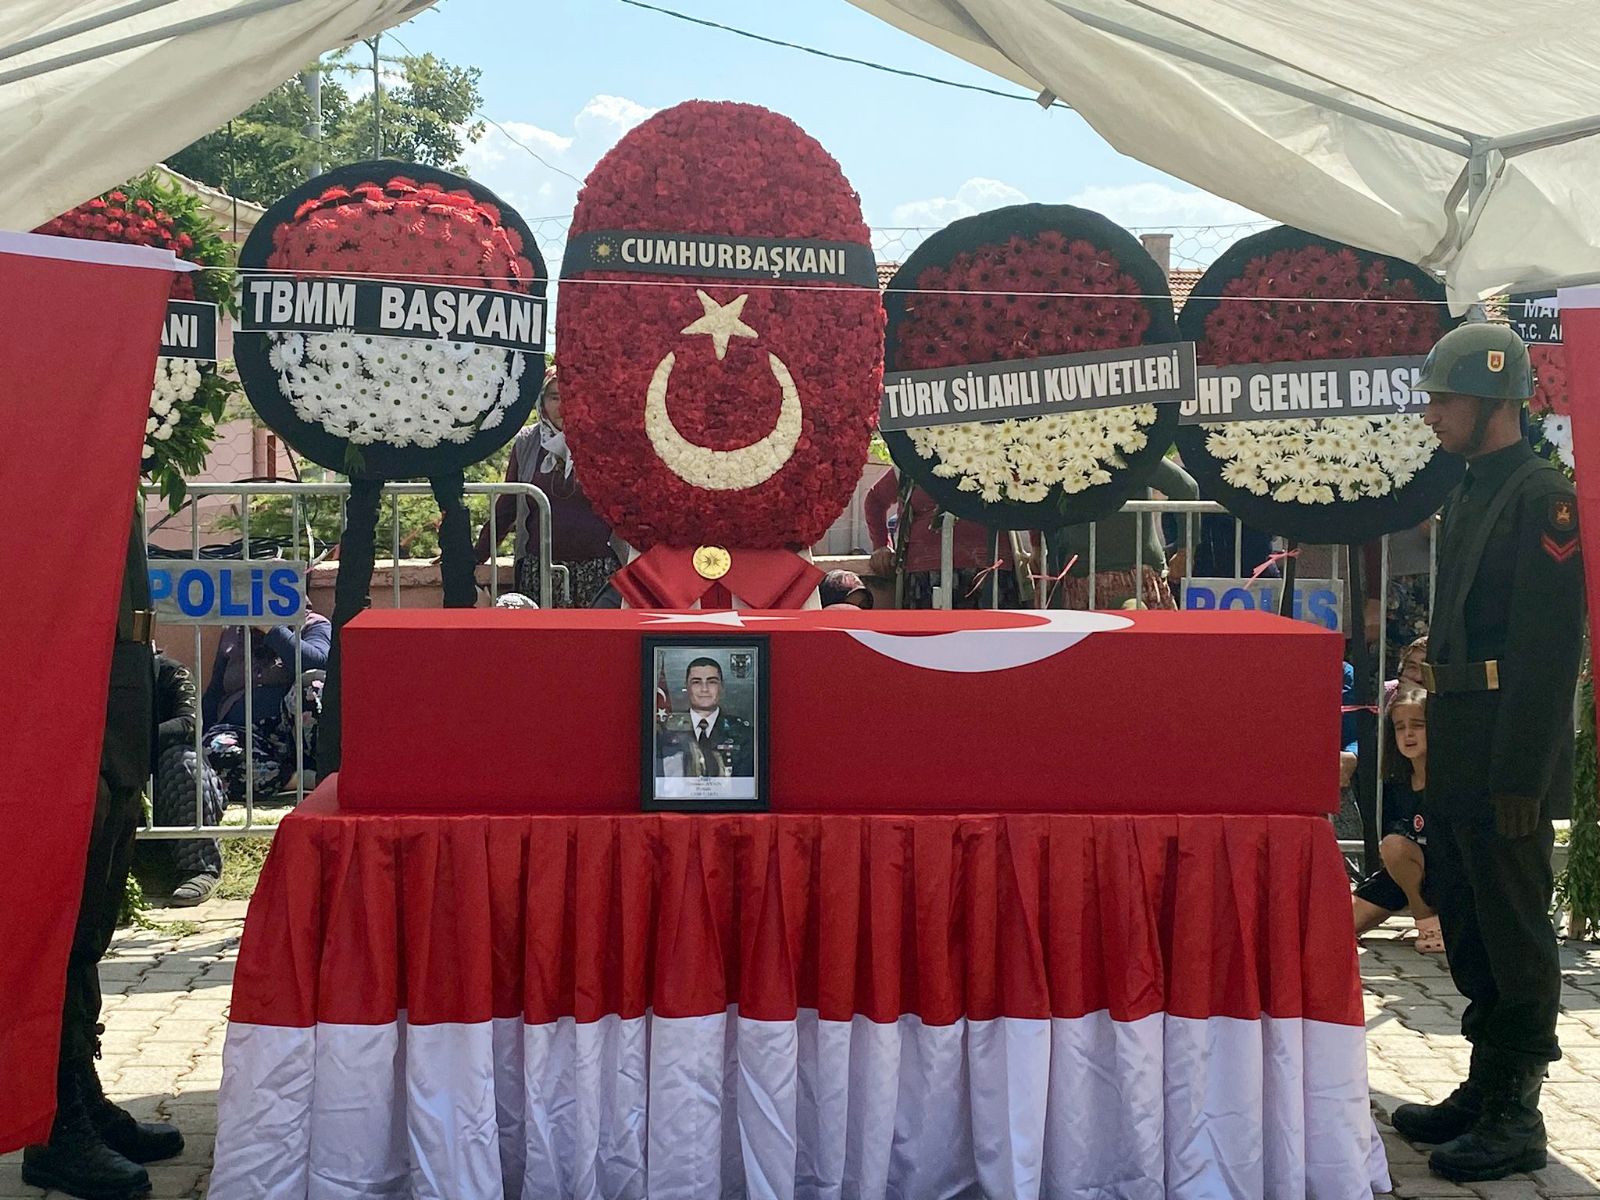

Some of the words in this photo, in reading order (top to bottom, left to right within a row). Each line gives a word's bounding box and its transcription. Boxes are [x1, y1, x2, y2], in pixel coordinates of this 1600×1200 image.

[621, 238, 845, 278] CUMHURBAŞKANI
[250, 281, 356, 326] TBMM
[380, 286, 543, 344] BAŞKANI
[1524, 299, 1559, 318] MA
[1518, 324, 1541, 340] T.C.
[885, 378, 950, 418] TÜRK
[952, 371, 1040, 412] SİLAHLI
[1044, 350, 1180, 402] KUVVETLERİ
[1249, 371, 1343, 412] GENEL
